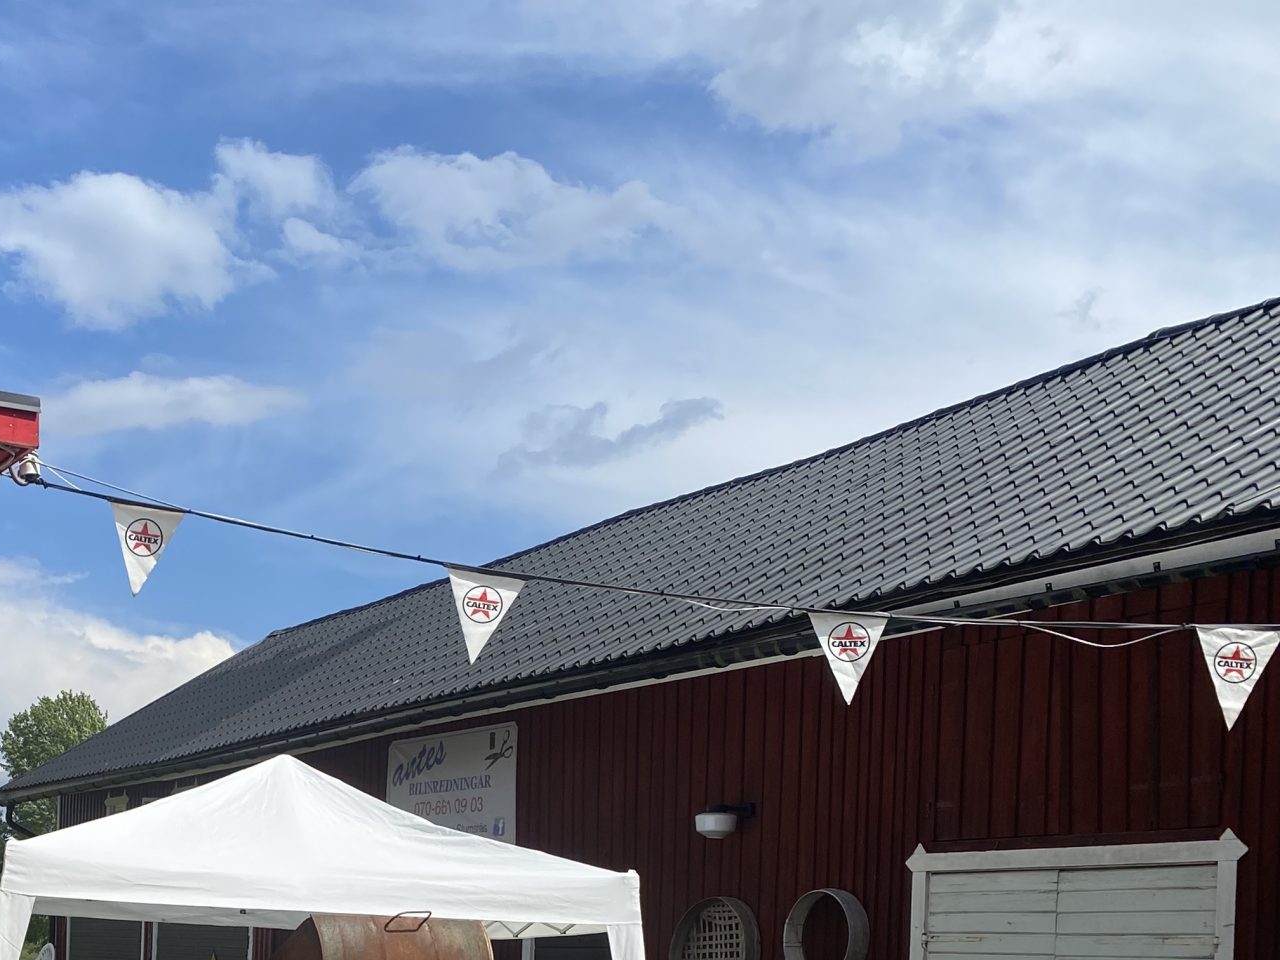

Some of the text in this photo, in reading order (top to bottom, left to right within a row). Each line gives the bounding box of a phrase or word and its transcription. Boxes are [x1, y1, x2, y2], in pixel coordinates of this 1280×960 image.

[128, 533, 159, 545] CALTEX
[466, 599, 499, 612] CALTEX
[831, 638, 866, 648] CALTEX
[1217, 660, 1253, 670] CALTEX
[409, 774, 491, 796] BILINREDNINGAR
[454, 798, 467, 813] 09
[470, 797, 483, 812] 03
